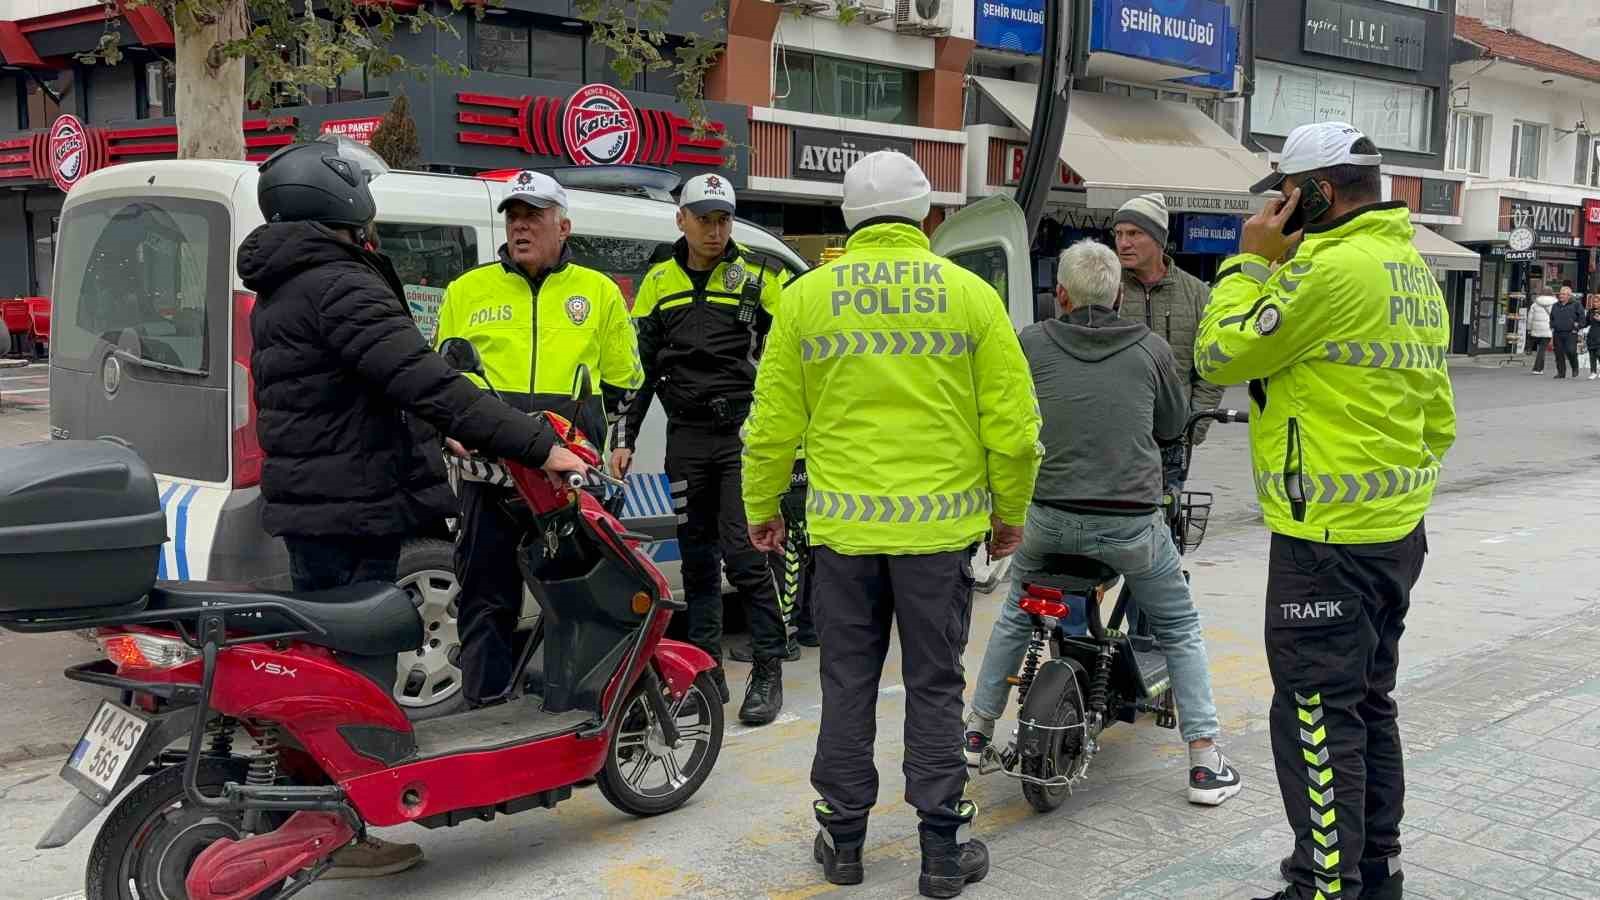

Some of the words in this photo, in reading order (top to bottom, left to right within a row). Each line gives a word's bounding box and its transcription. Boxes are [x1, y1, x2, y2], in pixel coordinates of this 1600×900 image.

[983, 3, 1010, 18] ŞEHİR
[1121, 7, 1161, 34] ŞEHİR
[1164, 17, 1214, 46] KULÜBÜ
[1531, 206, 1574, 233] YAKUT
[1280, 600, 1344, 620] TRAFIK
[251, 659, 298, 678] VSX
[109, 716, 142, 751] ACS
